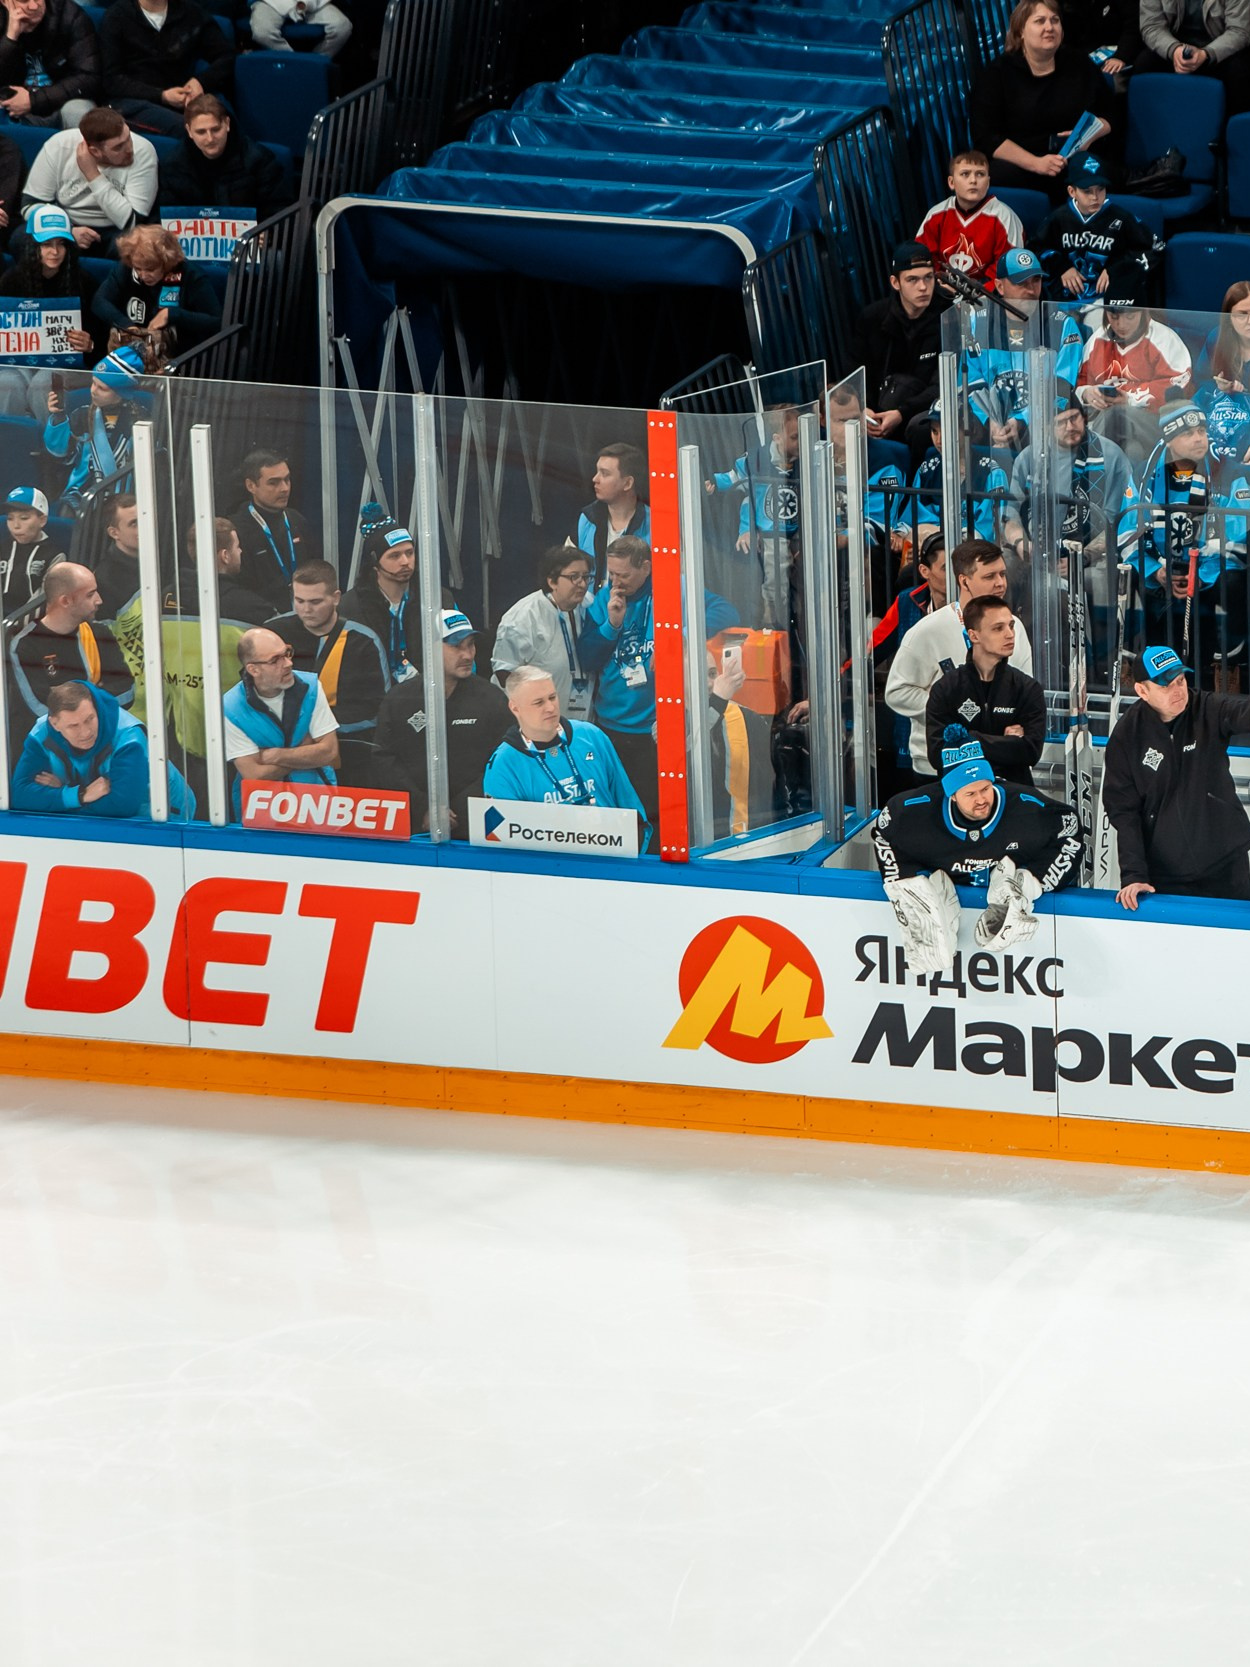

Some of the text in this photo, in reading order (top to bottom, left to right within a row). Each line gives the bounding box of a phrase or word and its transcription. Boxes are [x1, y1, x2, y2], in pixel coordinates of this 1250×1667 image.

[1109, 299, 1135, 307] CCM
[919, 352, 937, 361] CCM
[245, 789, 406, 831] FONBET
[509, 822, 623, 848] Ростелеком
[0, 860, 421, 1034] BET
